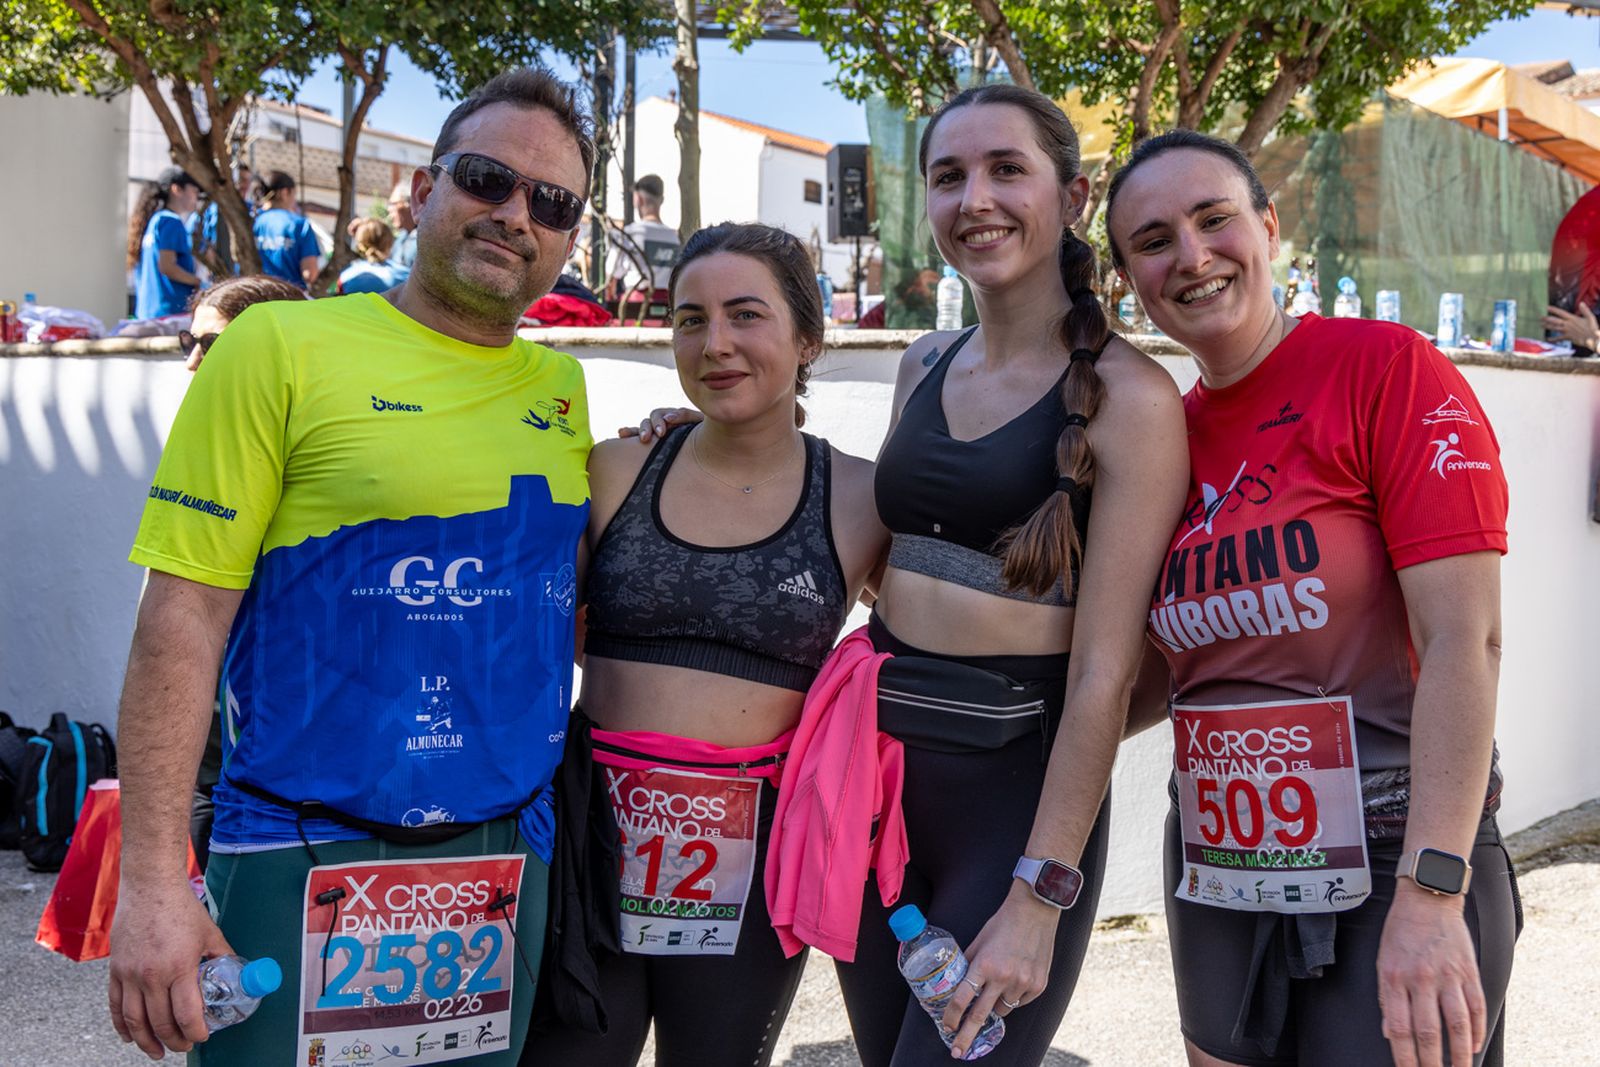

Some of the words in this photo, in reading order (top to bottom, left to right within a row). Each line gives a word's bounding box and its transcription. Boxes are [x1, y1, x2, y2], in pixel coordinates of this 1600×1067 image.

[1447, 461, 1491, 471] Aniversario
[178, 494, 238, 521] ALMUÑECAR
[351, 588, 420, 596] GUIJARRO
[430, 588, 512, 597] CONSULTORES
[778, 582, 824, 605] adidas
[406, 613, 465, 622] ABOGADOS
[420, 676, 451, 692] L.P.
[406, 732, 463, 751] ALMUÑECAR
[1185, 719, 1204, 755] X
[1207, 725, 1313, 758] CROSS
[1188, 756, 1287, 782] PANTANO
[1291, 760, 1315, 772] DEL
[606, 767, 629, 805] X
[629, 787, 726, 821] CROSS
[1197, 776, 1319, 849] 509
[704, 827, 723, 838] DEL
[1201, 848, 1242, 867] TERESA
[342, 874, 379, 912] X
[385, 880, 490, 911] CROSS
[341, 911, 468, 938] PANTANO
[471, 913, 488, 924] DEL
[316, 925, 504, 1010] 2582
